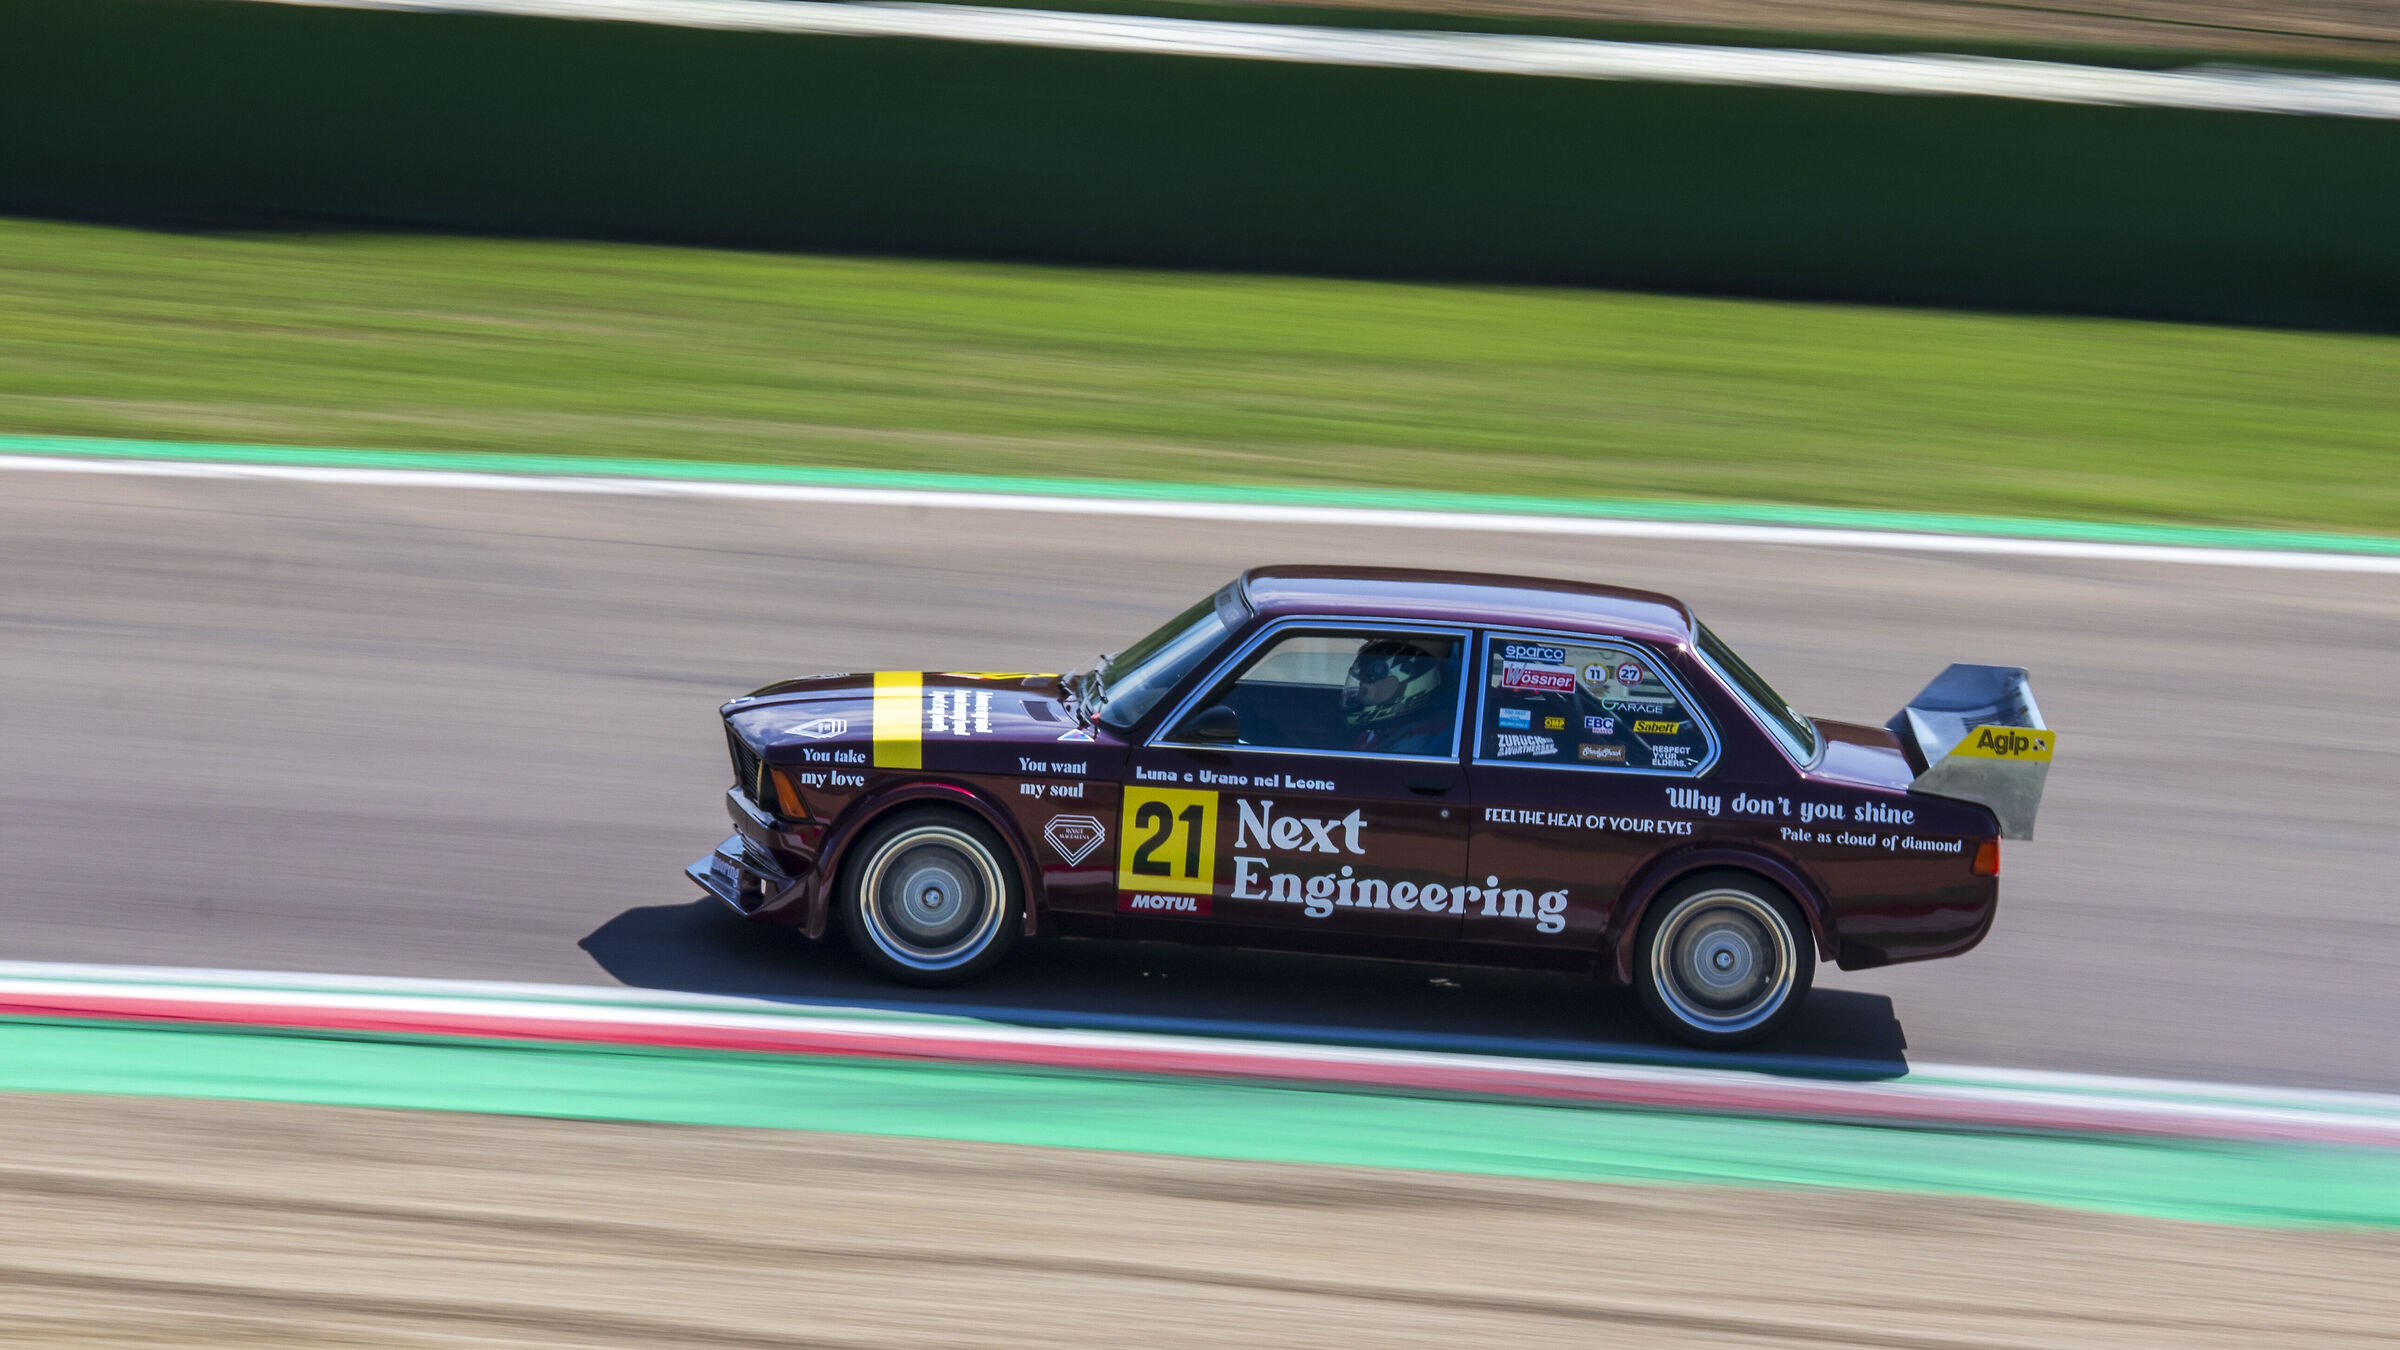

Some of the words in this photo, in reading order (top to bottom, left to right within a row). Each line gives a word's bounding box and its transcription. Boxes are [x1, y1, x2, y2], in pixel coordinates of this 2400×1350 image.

[1506, 645, 1563, 659] sparco
[1506, 663, 1572, 687] Wössner
[1590, 669, 1601, 680] 11
[1621, 669, 1638, 680] 27
[1602, 697, 1663, 714] GARAGE
[1545, 719, 1565, 728] OMP
[1586, 717, 1612, 729] EBC
[1636, 721, 1675, 733] Sabelt
[1652, 745, 1690, 755] RESPECT
[1977, 729, 2029, 756] Agip
[803, 748, 831, 763] You
[834, 749, 866, 763] take
[1019, 757, 1047, 772] You
[1051, 761, 1087, 774] want
[801, 771, 827, 788] my
[831, 770, 865, 787] love
[1136, 766, 1177, 781] Luna
[1184, 772, 1193, 782] e
[1200, 770, 1248, 785] Urano
[1254, 774, 1279, 787] nel
[1285, 775, 1335, 790] Leone
[1020, 783, 1046, 799] my
[1050, 782, 1084, 798] soul
[1666, 788, 1721, 815] Why
[1732, 793, 1791, 816] don't
[1800, 802, 1845, 823] you
[1854, 802, 1915, 825] shine
[1234, 799, 1367, 854] Next
[1485, 808, 1516, 822] FEEL
[1518, 810, 1545, 825] THE
[1548, 813, 1583, 828] HEAT
[1585, 815, 1606, 829] OF
[1609, 817, 1654, 832] YOUR
[1657, 820, 1692, 835] EYES
[1132, 801, 1204, 878] 21
[1781, 827, 1812, 842] Pale
[1817, 834, 1832, 843] as
[1837, 831, 1876, 847] cloud
[1882, 835, 1899, 851] of
[1902, 837, 1962, 853] diamond
[1131, 895, 1197, 911] MOTUL
[1231, 856, 1569, 933] Engineering
